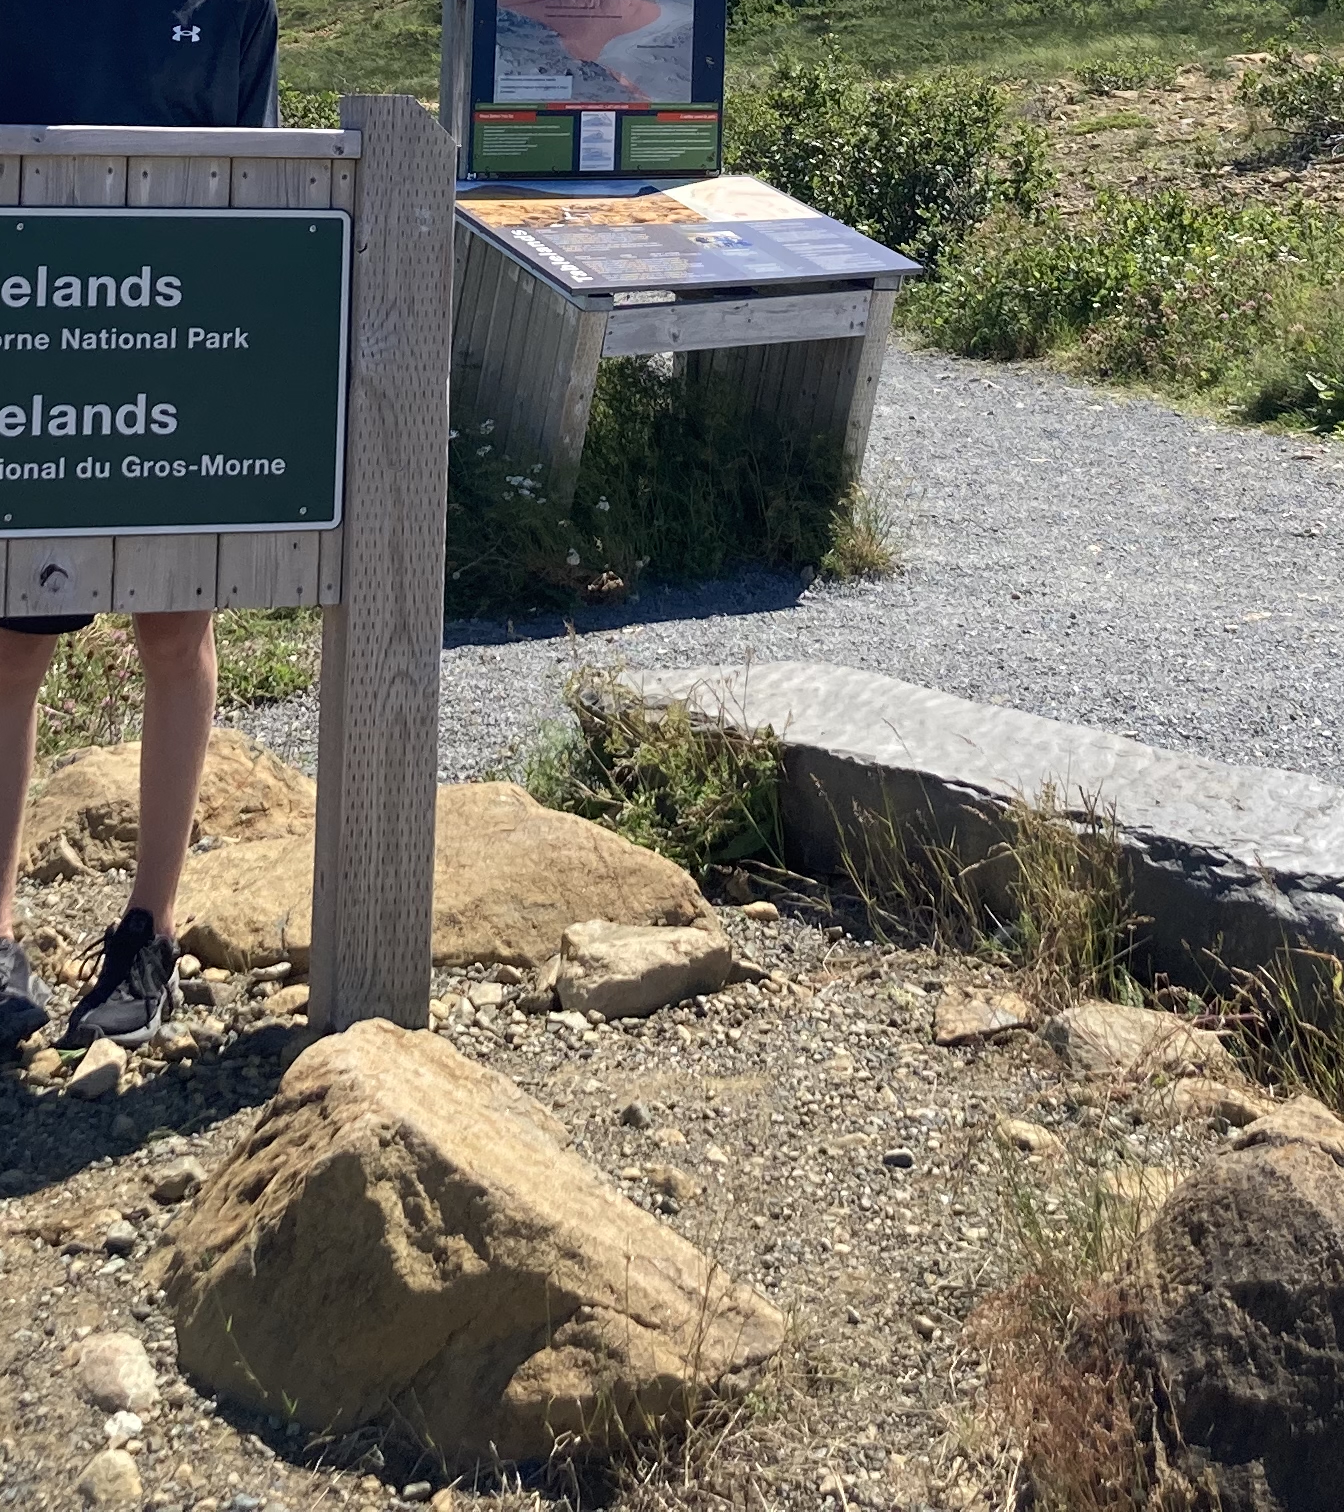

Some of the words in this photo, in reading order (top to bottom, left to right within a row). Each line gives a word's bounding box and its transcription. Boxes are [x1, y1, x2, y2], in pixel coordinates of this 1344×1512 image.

[510, 228, 594, 284] Tablelands
[61, 327, 177, 350] National
[187, 327, 249, 349] Park
[76, 456, 111, 479] du
[121, 454, 286, 478] Gros-Morne
